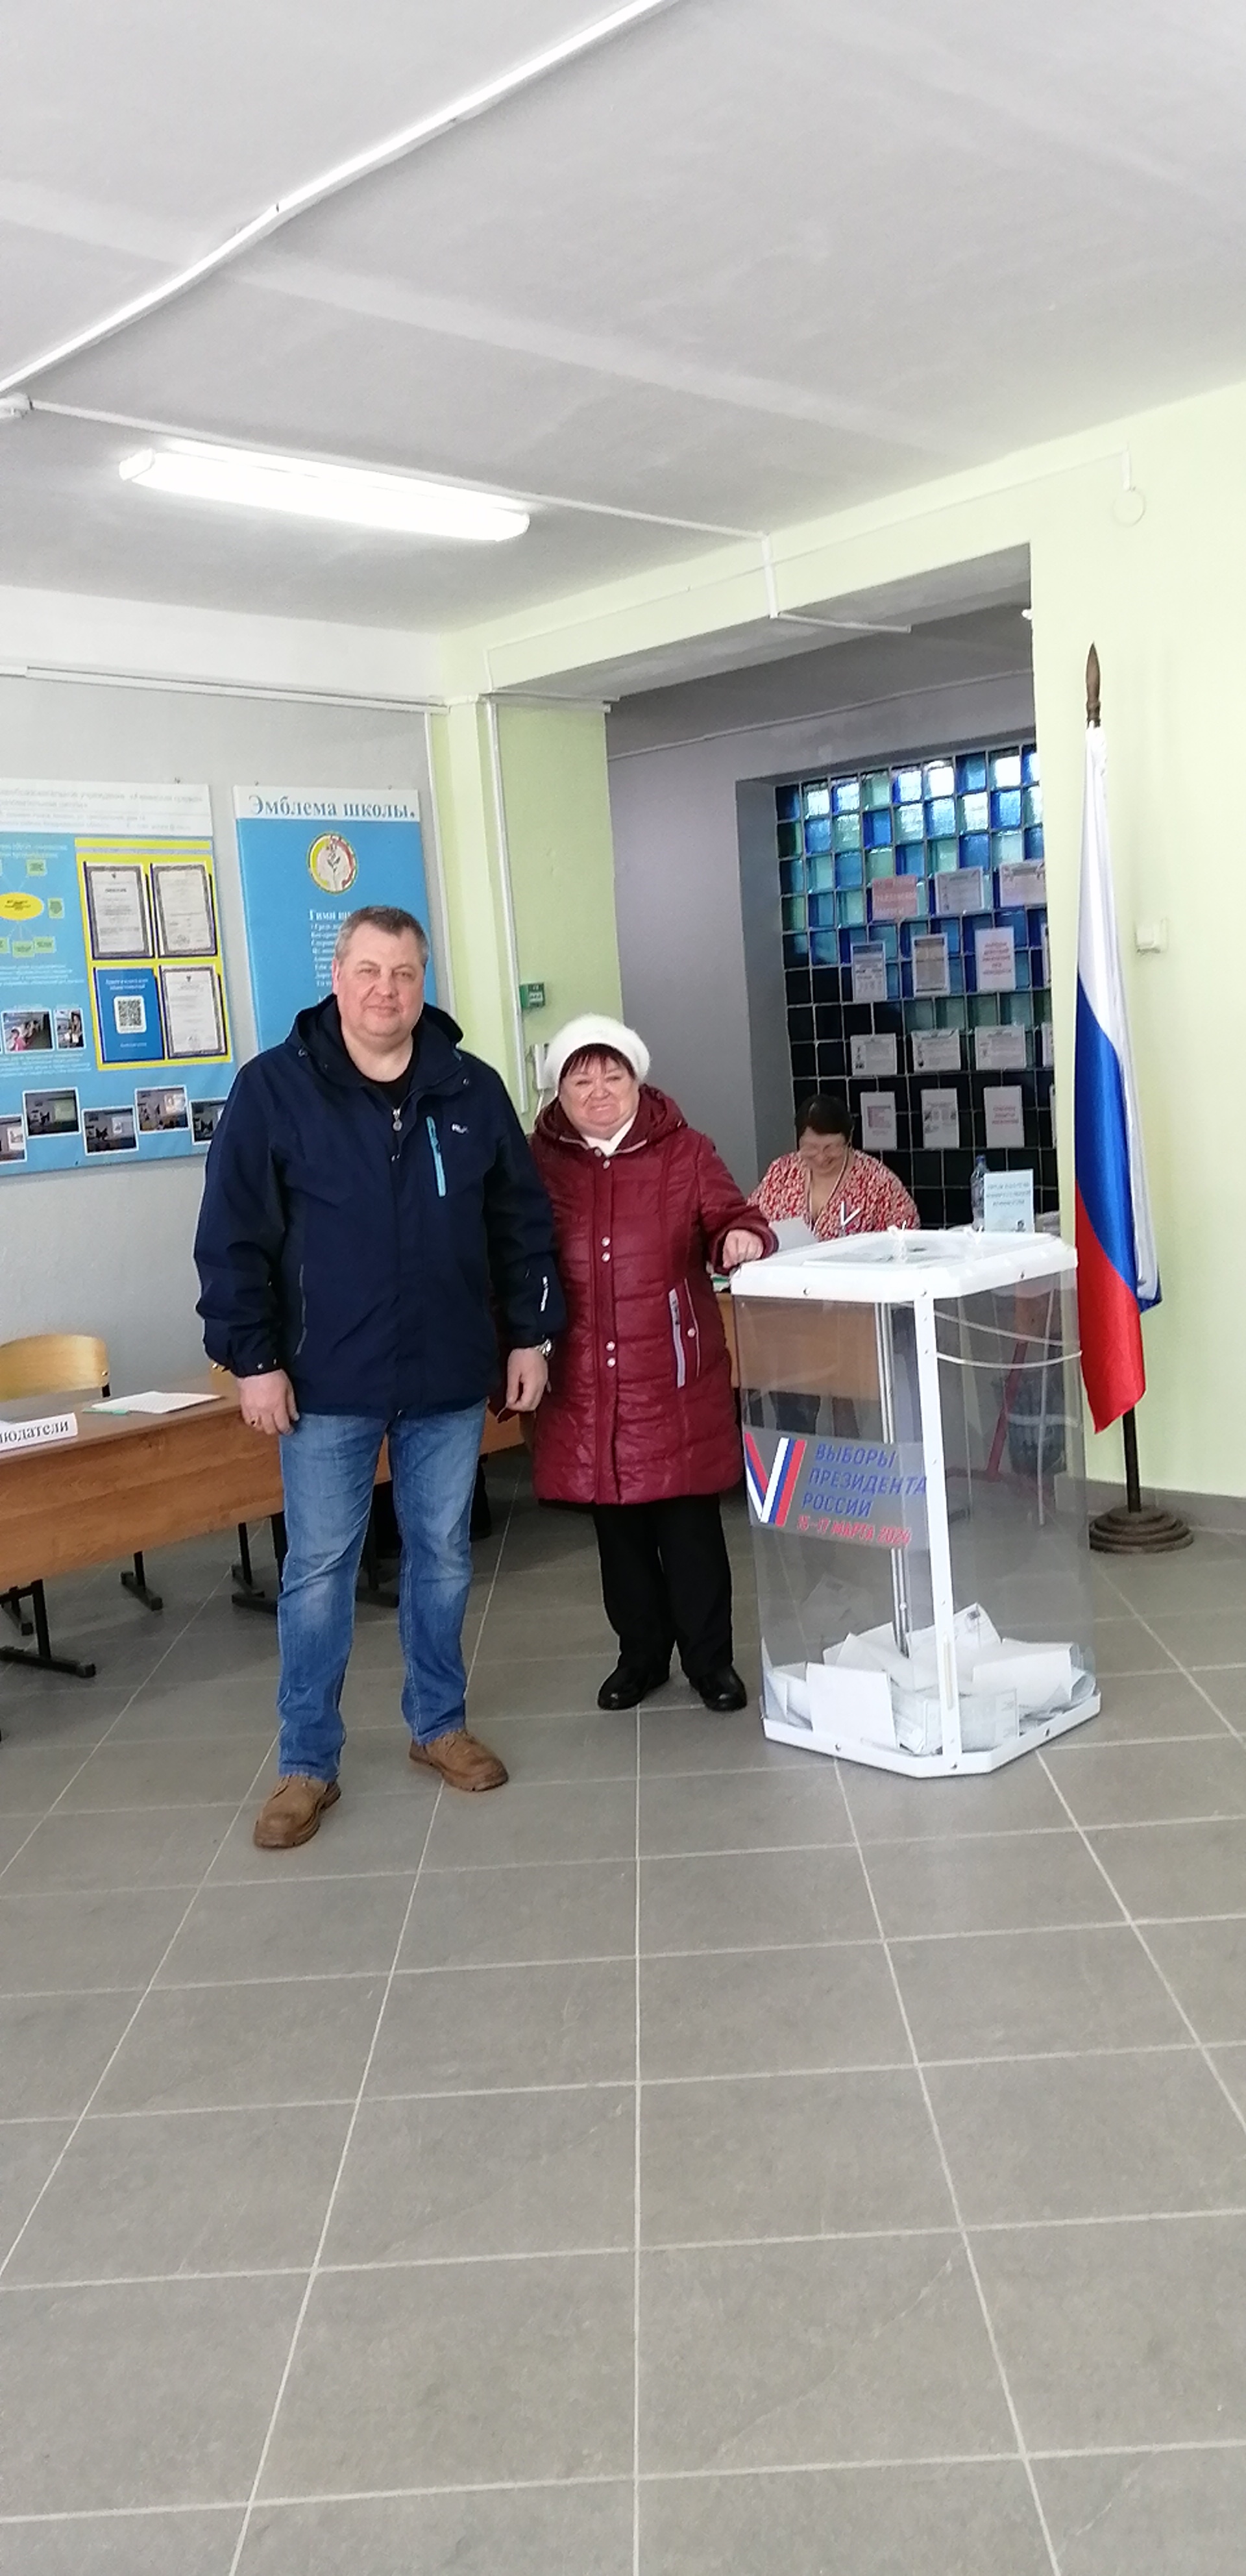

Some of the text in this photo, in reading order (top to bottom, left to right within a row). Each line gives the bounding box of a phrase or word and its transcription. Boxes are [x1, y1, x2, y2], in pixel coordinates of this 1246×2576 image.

[249, 795, 416, 819] Эмблема школы.
[814, 1443, 896, 1468] ВЫБОРЫ
[809, 1467, 927, 1496] ПРЕЗИДЕНТА
[801, 1492, 873, 1518] РОССИИ
[831, 1520, 875, 1541] МАРТА
[877, 1526, 911, 1545] 2024
